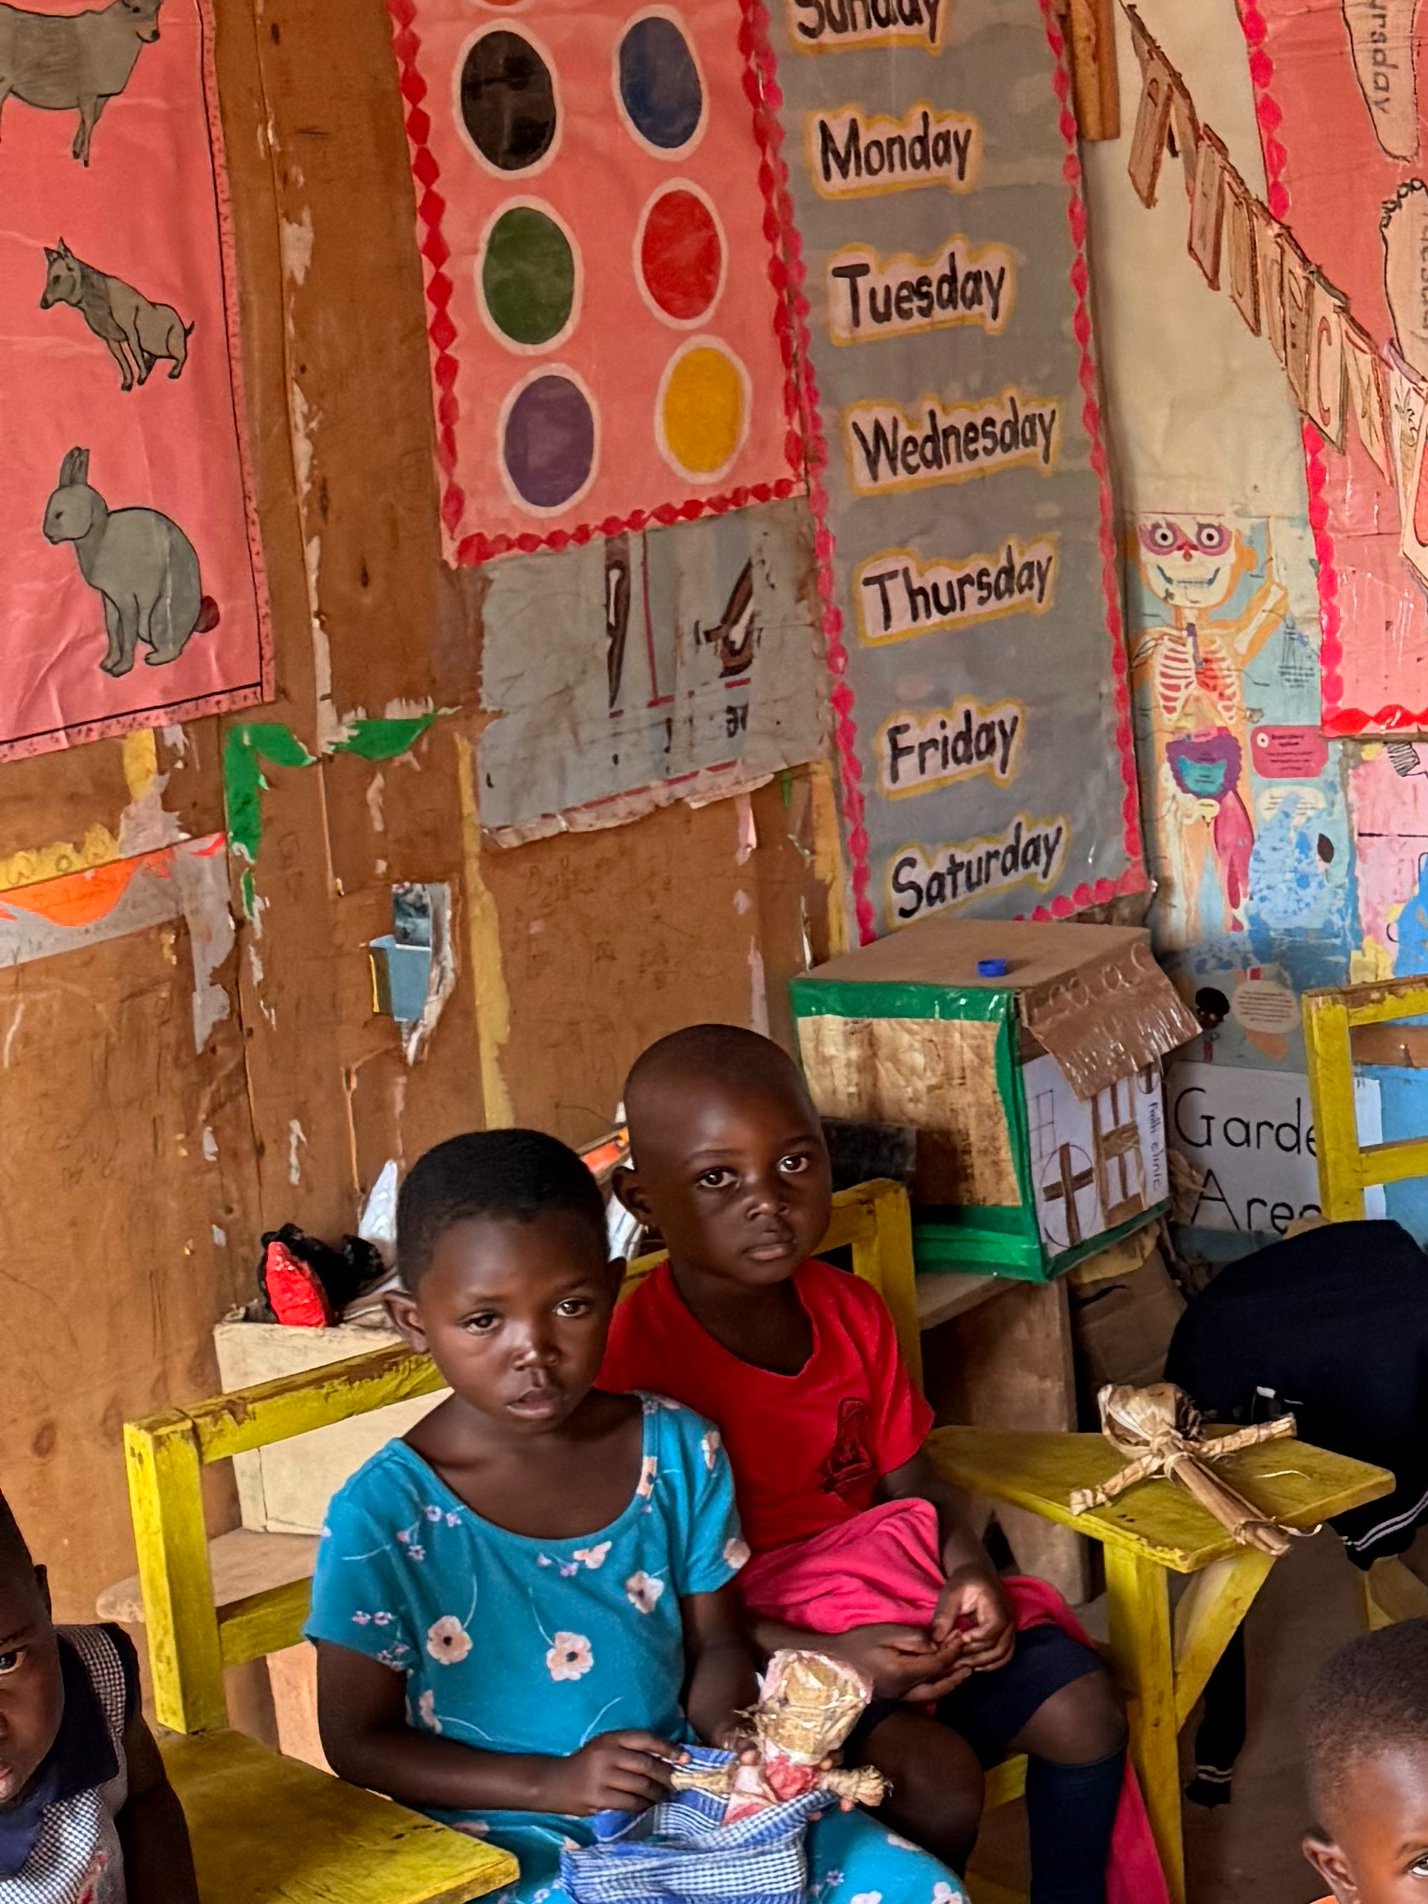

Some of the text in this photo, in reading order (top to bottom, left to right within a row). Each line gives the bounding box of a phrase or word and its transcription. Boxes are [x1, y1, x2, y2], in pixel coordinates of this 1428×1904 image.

[819, 110, 972, 182] Monday
[831, 251, 1006, 328] Tuesday
[852, 395, 1056, 482] Wednesday
[862, 544, 1053, 632] Thursday
[886, 708, 1019, 784] Friday
[891, 820, 1063, 919] Saturday
[1174, 1087, 1317, 1156] Garde
